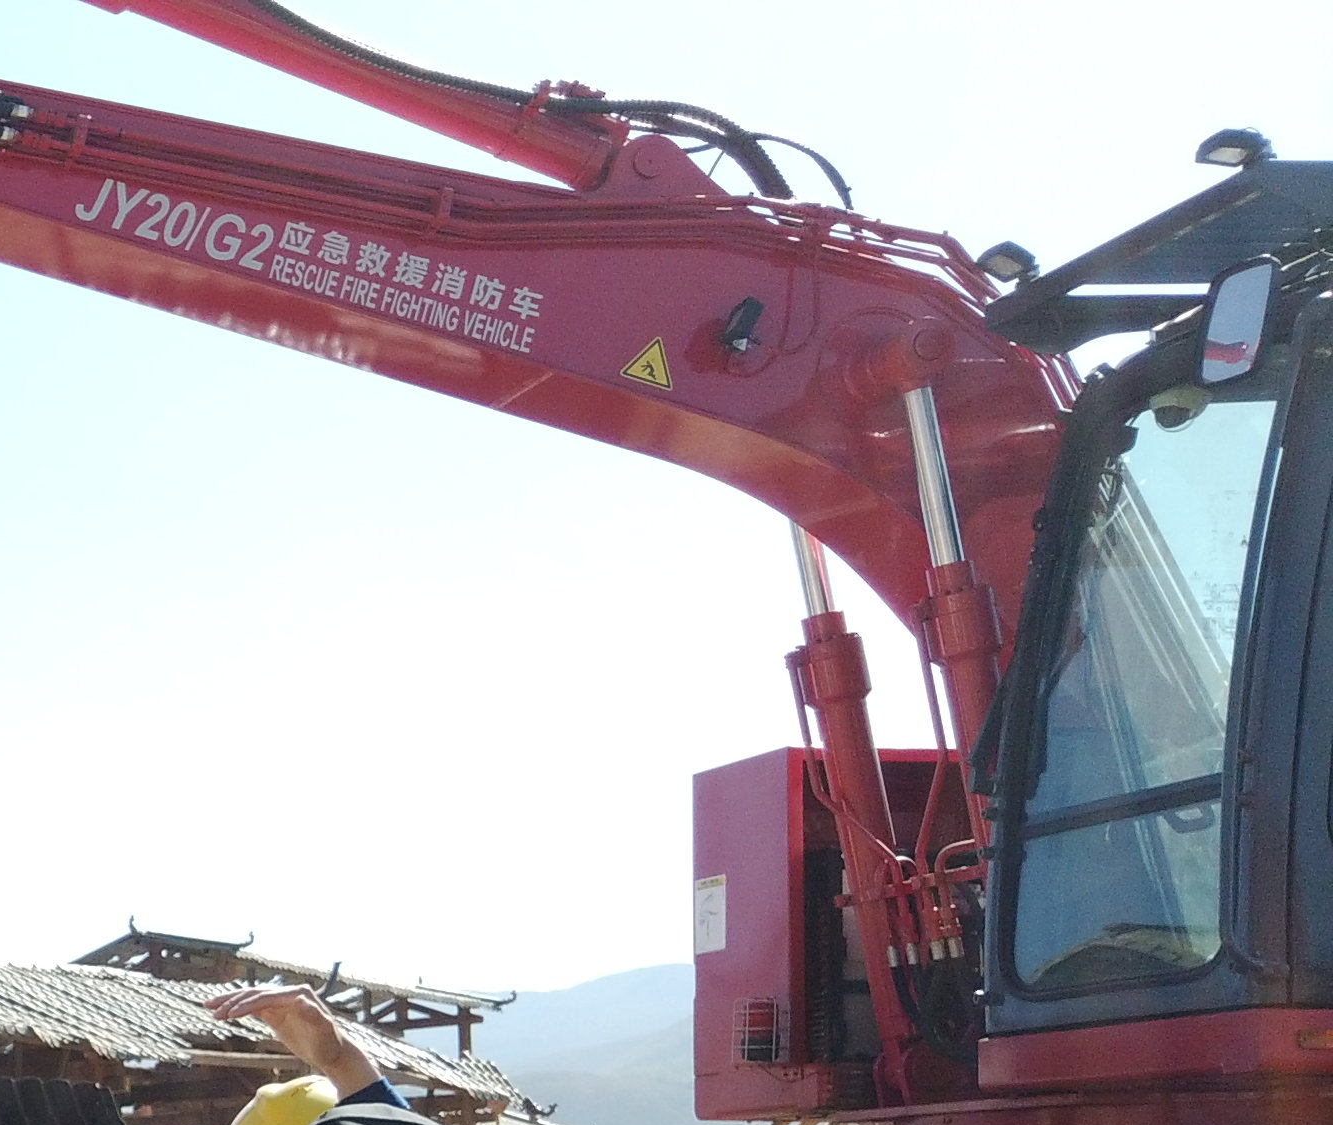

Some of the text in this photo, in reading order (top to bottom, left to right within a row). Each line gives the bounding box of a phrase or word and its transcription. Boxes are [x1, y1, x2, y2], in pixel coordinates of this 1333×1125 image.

[74, 178, 275, 271] JY20/G2
[279, 221, 544, 320] 应急救援消防车
[269, 254, 535, 353] RESCUE FIRE FIGHTING VEHICLE
